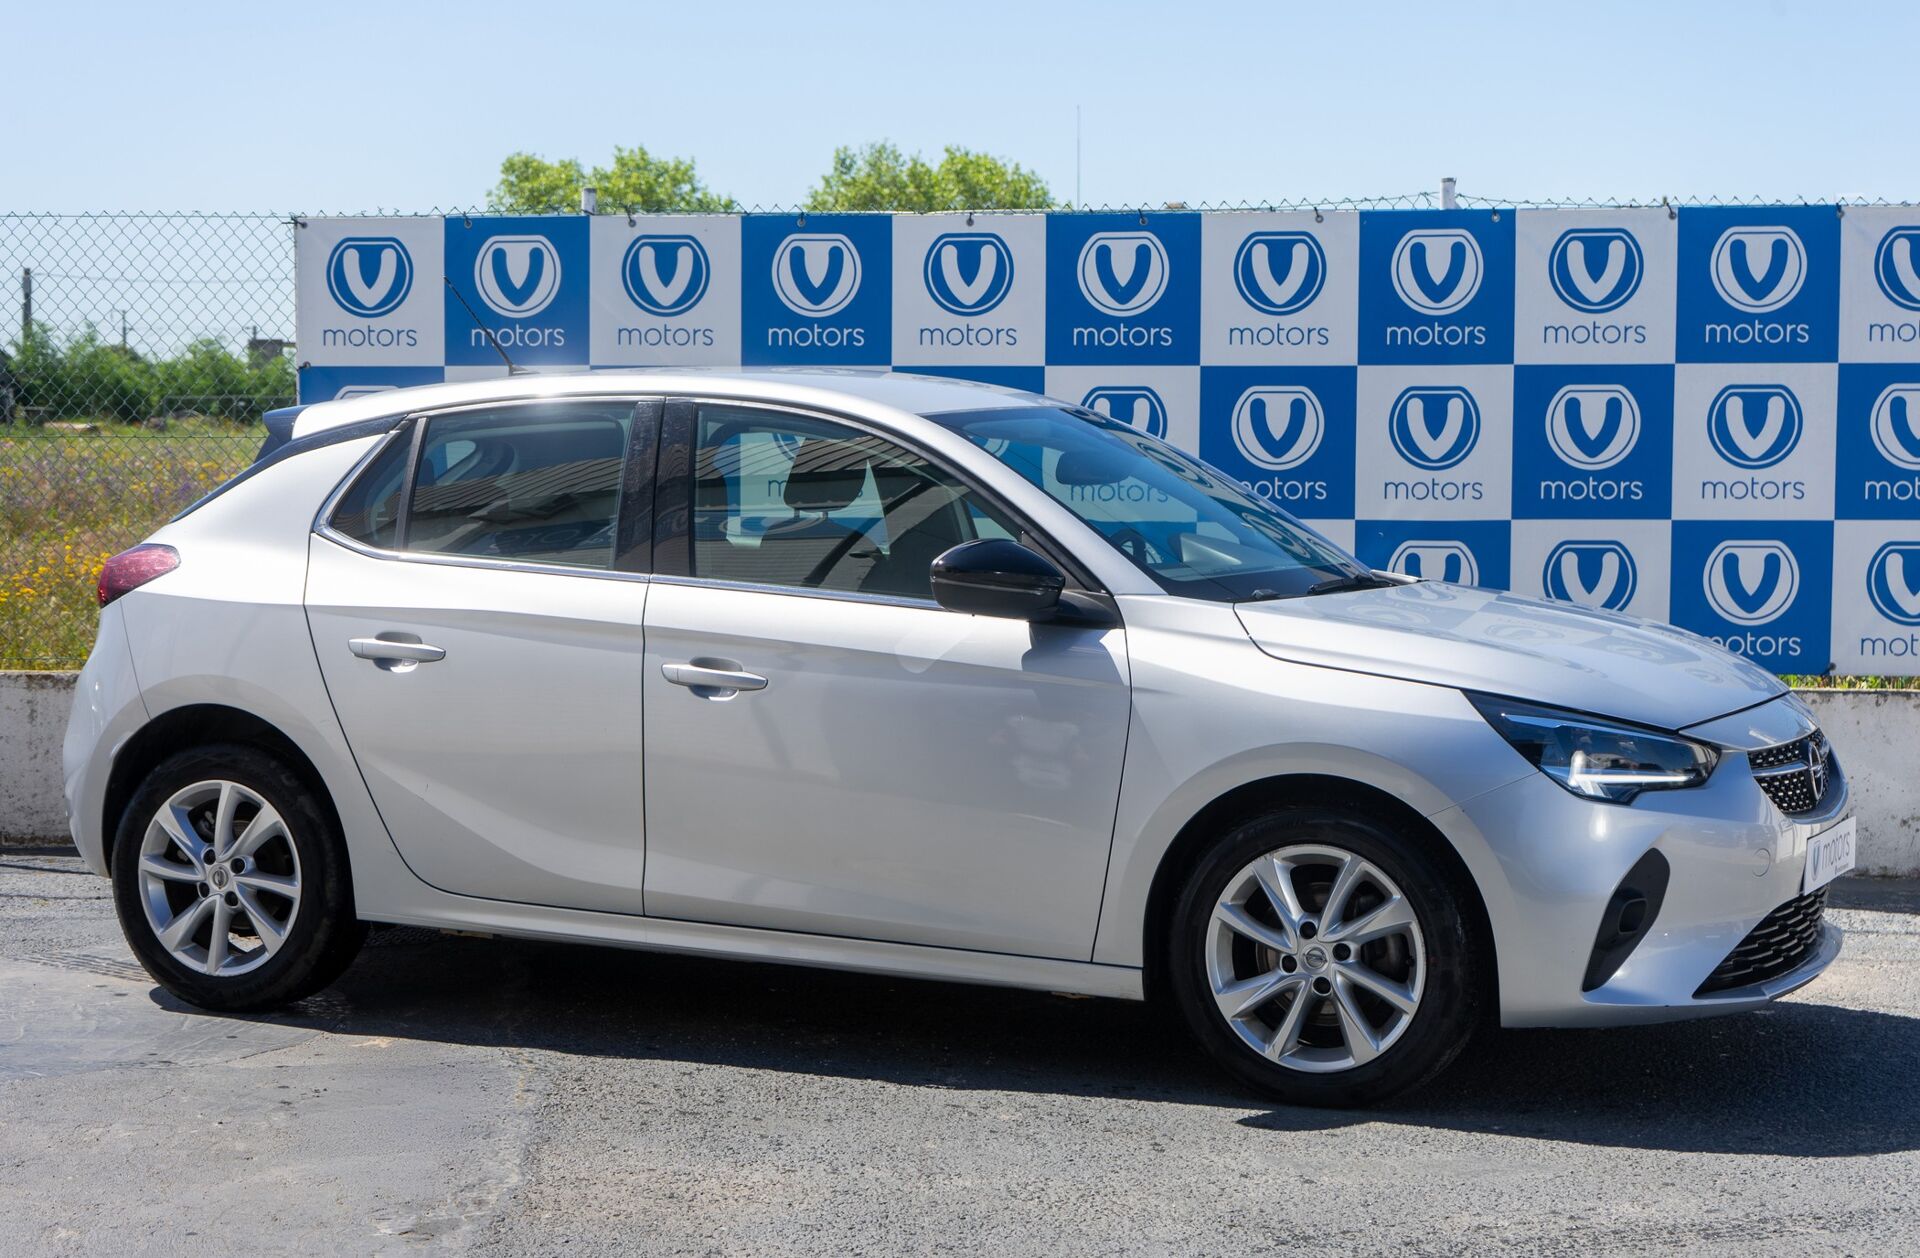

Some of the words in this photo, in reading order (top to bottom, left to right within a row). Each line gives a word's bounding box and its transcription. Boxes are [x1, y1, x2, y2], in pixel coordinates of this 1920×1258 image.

[323, 323, 418, 348] motors
[471, 323, 565, 347] motors
[617, 323, 714, 347] motors
[767, 322, 865, 347] motors
[919, 323, 1017, 347] motors
[1073, 322, 1173, 347] motors
[1229, 322, 1329, 346] motors
[1386, 321, 1486, 346] motors
[1543, 320, 1646, 345] motors
[1705, 319, 1810, 344] motors
[1071, 480, 1169, 502] motors
[1384, 477, 1483, 501] motors
[1540, 477, 1643, 501] motors
[1701, 476, 1805, 501] motors
[1704, 631, 1802, 656] otors
[1822, 831, 1850, 870] motors
